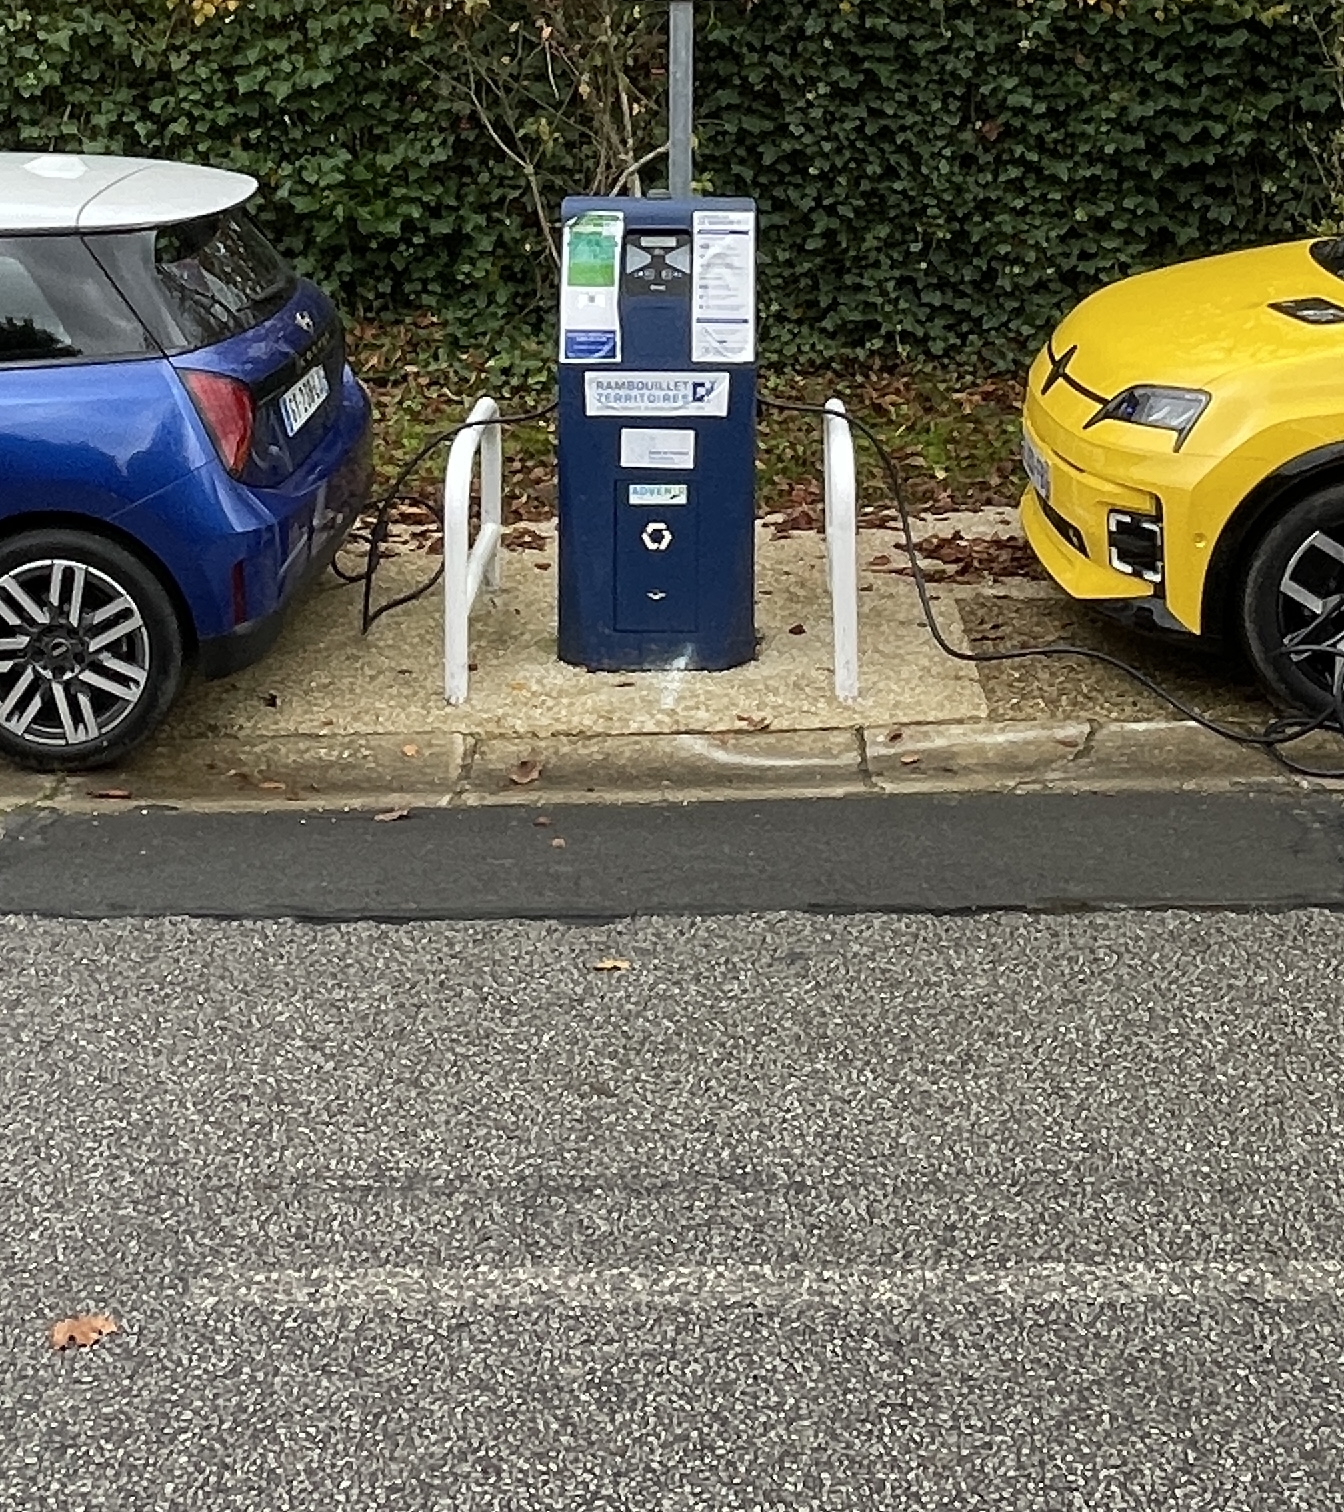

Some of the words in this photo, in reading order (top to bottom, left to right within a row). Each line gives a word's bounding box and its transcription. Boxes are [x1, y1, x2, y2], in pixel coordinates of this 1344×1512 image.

[596, 380, 690, 392] RAMBOUILLET
[596, 392, 690, 404] TERRITOIRES
[631, 486, 685, 496] ADVENIR
